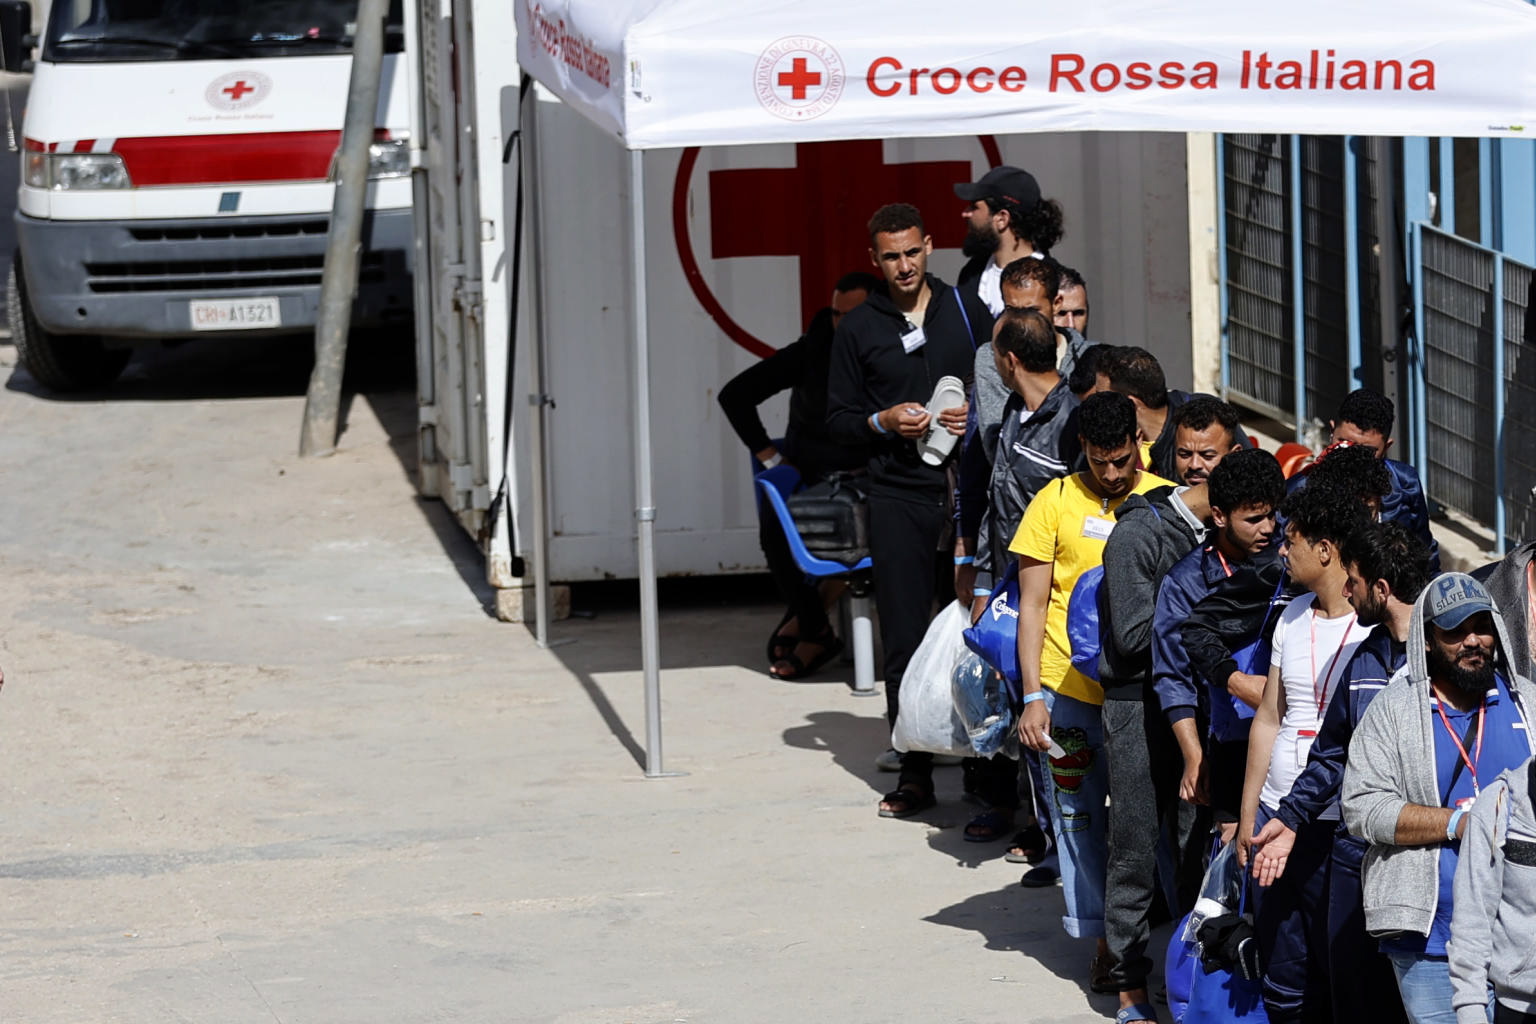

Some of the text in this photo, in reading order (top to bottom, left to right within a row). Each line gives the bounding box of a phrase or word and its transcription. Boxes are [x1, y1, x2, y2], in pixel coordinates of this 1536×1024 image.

[866, 49, 1436, 98] Croce Rossa Italiana
